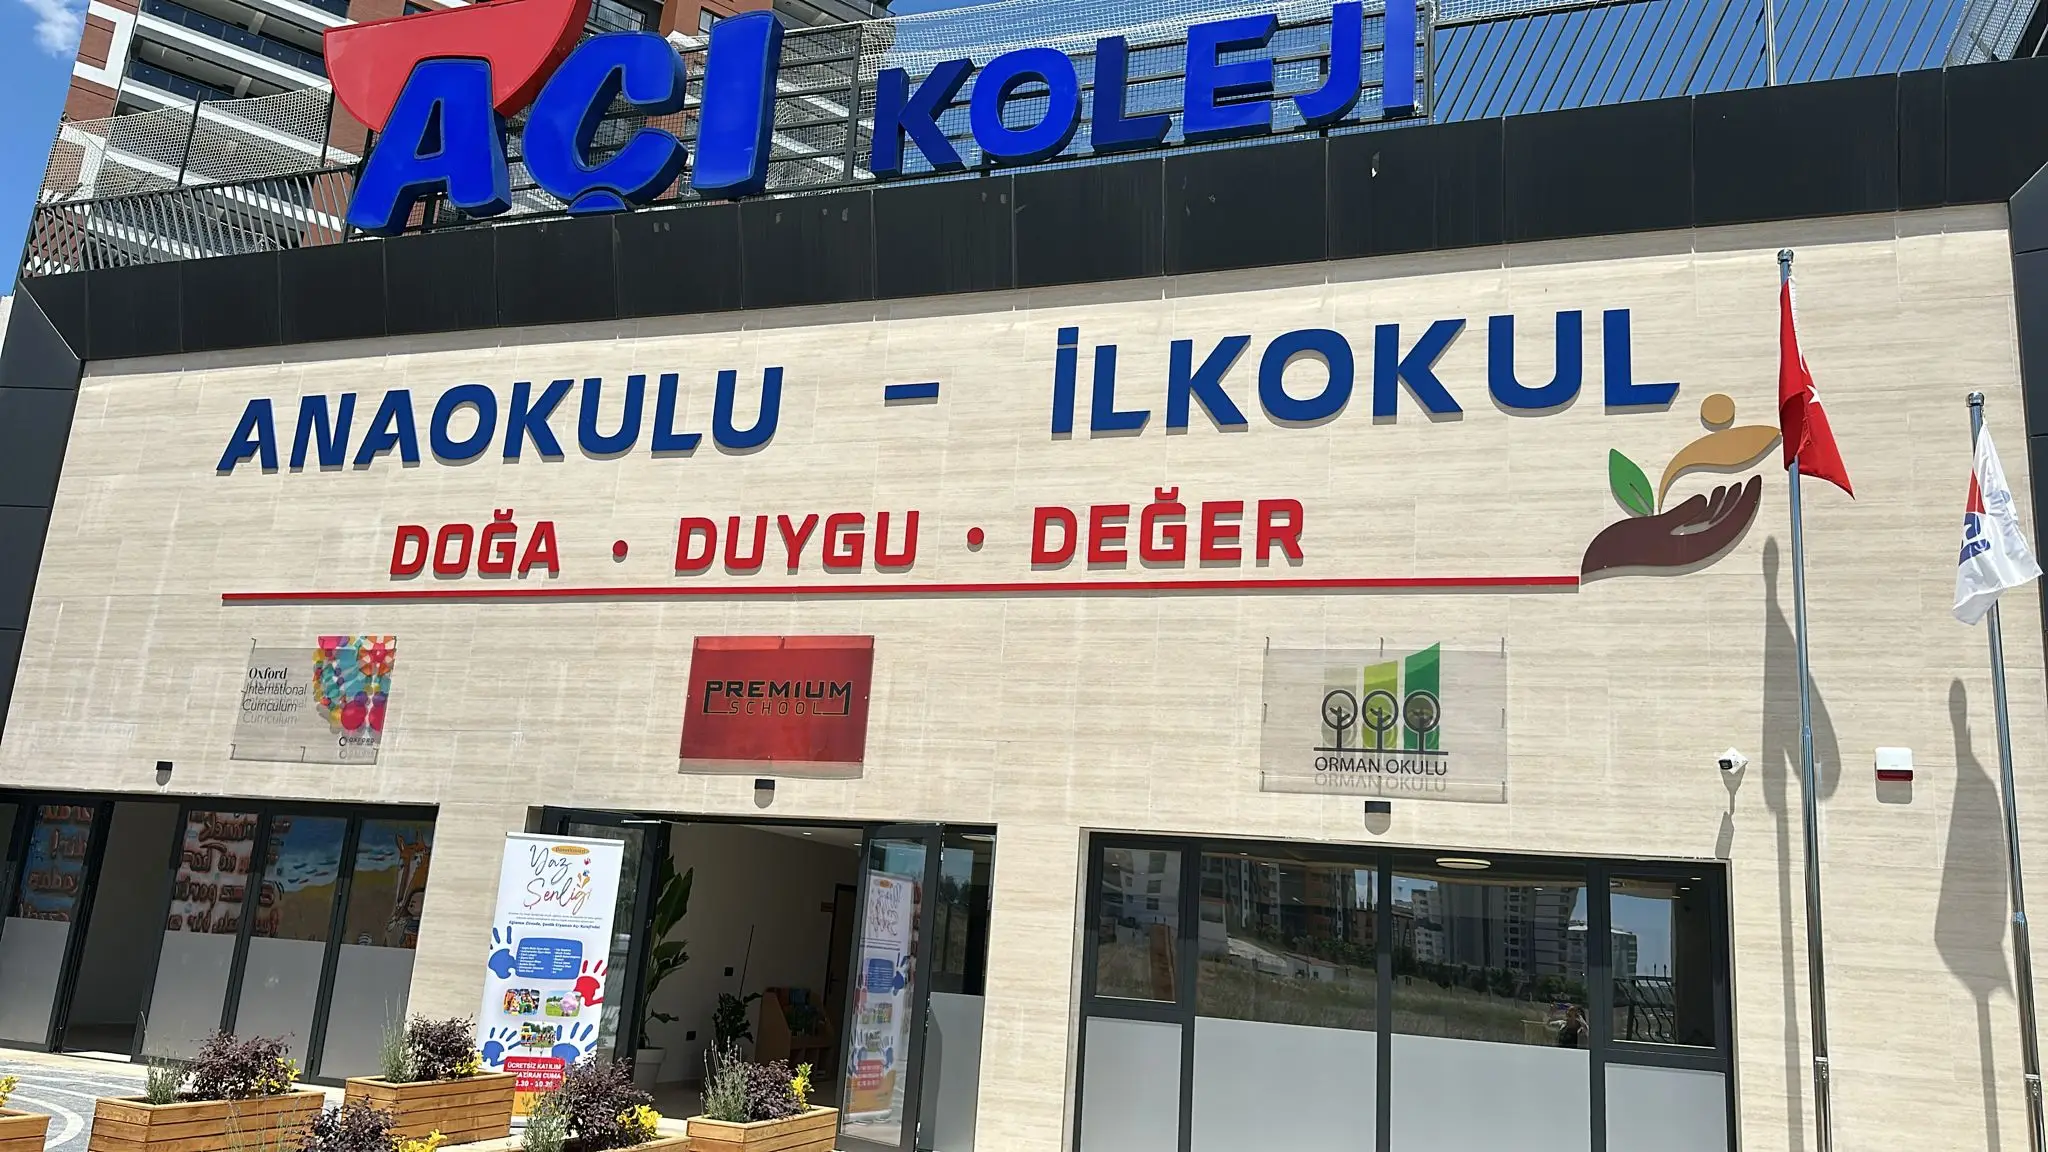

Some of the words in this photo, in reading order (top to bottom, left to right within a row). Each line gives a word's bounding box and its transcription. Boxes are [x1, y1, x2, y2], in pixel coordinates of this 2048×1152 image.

[346, 10, 785, 236] AÇI
[217, 367, 784, 473] ANAOKULU
[1051, 308, 1680, 439] İLKOKUL
[389, 509, 560, 578] DOĞA
[675, 511, 920, 574] DUYGU
[1030, 487, 1304, 567] DEĞER
[249, 667, 288, 680] Oxford
[245, 683, 308, 695] International
[704, 680, 852, 714] PREMIUM
[242, 699, 298, 712] Curriculum
[729, 702, 823, 715] SCHOOL
[1314, 756, 1380, 773] ORMAN
[1385, 759, 1447, 776] OKULU
[529, 844, 573, 885] Yaz
